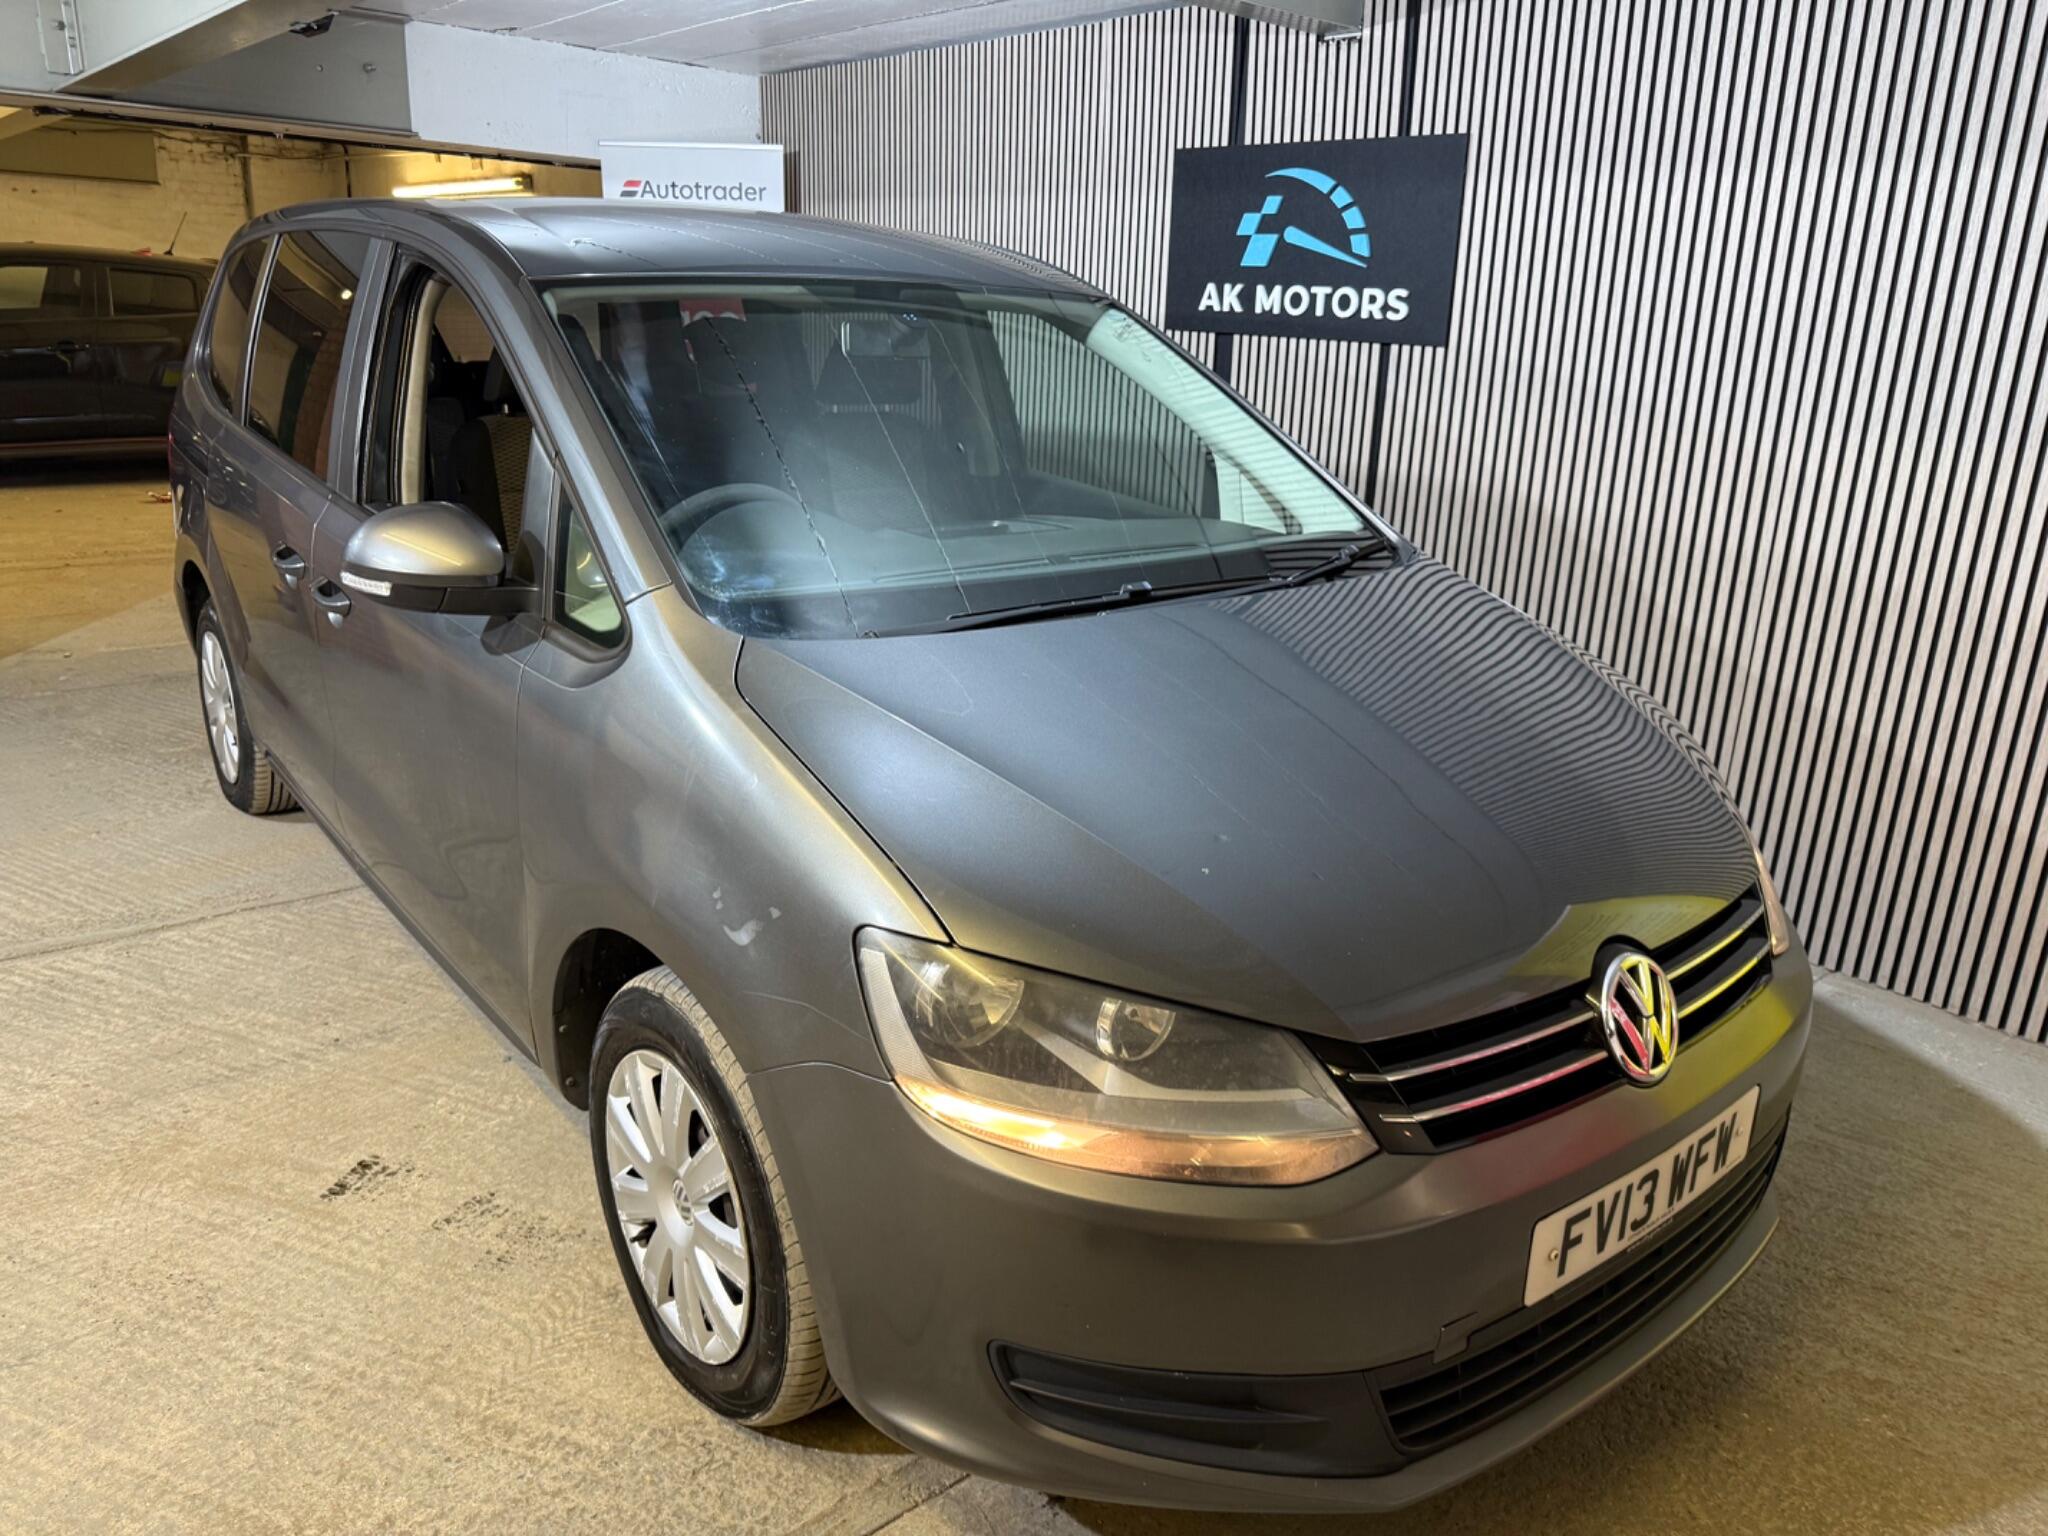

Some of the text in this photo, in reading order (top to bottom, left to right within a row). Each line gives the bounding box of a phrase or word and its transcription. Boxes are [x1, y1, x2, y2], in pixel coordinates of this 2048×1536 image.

[640, 180, 767, 202] Autotrader
[1198, 282, 1410, 321] AK MOTORS
[1557, 1111, 1737, 1279] FV13 WFW
